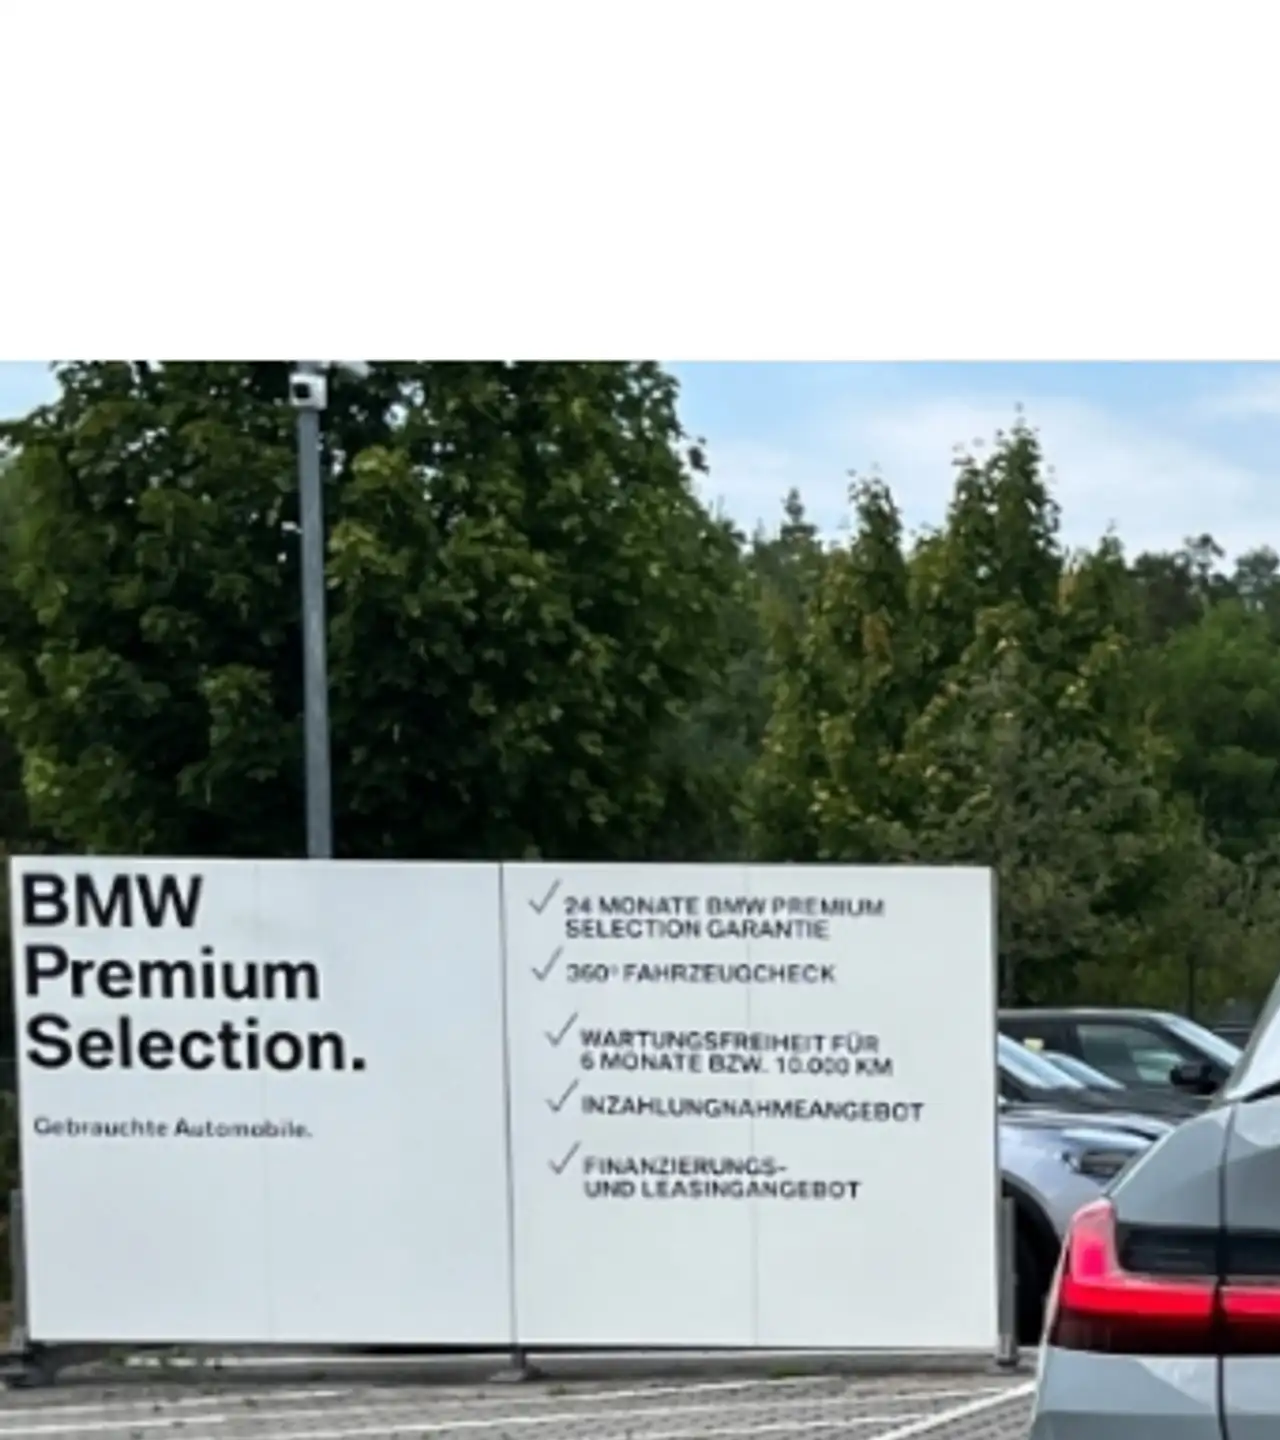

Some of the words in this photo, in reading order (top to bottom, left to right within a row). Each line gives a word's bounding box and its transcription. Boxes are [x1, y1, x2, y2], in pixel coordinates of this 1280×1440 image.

[22, 873, 203, 928] BMW
[565, 896, 591, 916] 24
[600, 896, 699, 917] MONATE
[706, 897, 766, 917] BMW
[772, 898, 884, 918] PREMIUM
[565, 919, 700, 939] SELECTION
[708, 920, 829, 940] GARANTIE
[25, 943, 320, 1000] Premium
[623, 964, 836, 984] FAHRZEUGCHECK
[26, 1012, 367, 1071] Selection.
[580, 1031, 826, 1054] WARTUNGSFREIHEIT
[832, 1033, 879, 1055] FÜR
[580, 1054, 594, 1071] 6
[600, 1054, 702, 1073] MONATE
[709, 1055, 769, 1074] BZW.
[777, 1057, 849, 1076] 10.000
[856, 1058, 893, 1077] KM
[581, 1097, 924, 1122] INZAHLUNGNAHMEANGEBOT
[34, 1117, 168, 1138] Gebrauchte
[174, 1118, 313, 1139] Automobile.
[583, 1157, 787, 1176] FINANZIERUNGS-
[584, 1180, 635, 1199] UND
[642, 1181, 861, 1200] LEASINGANGEBOT
